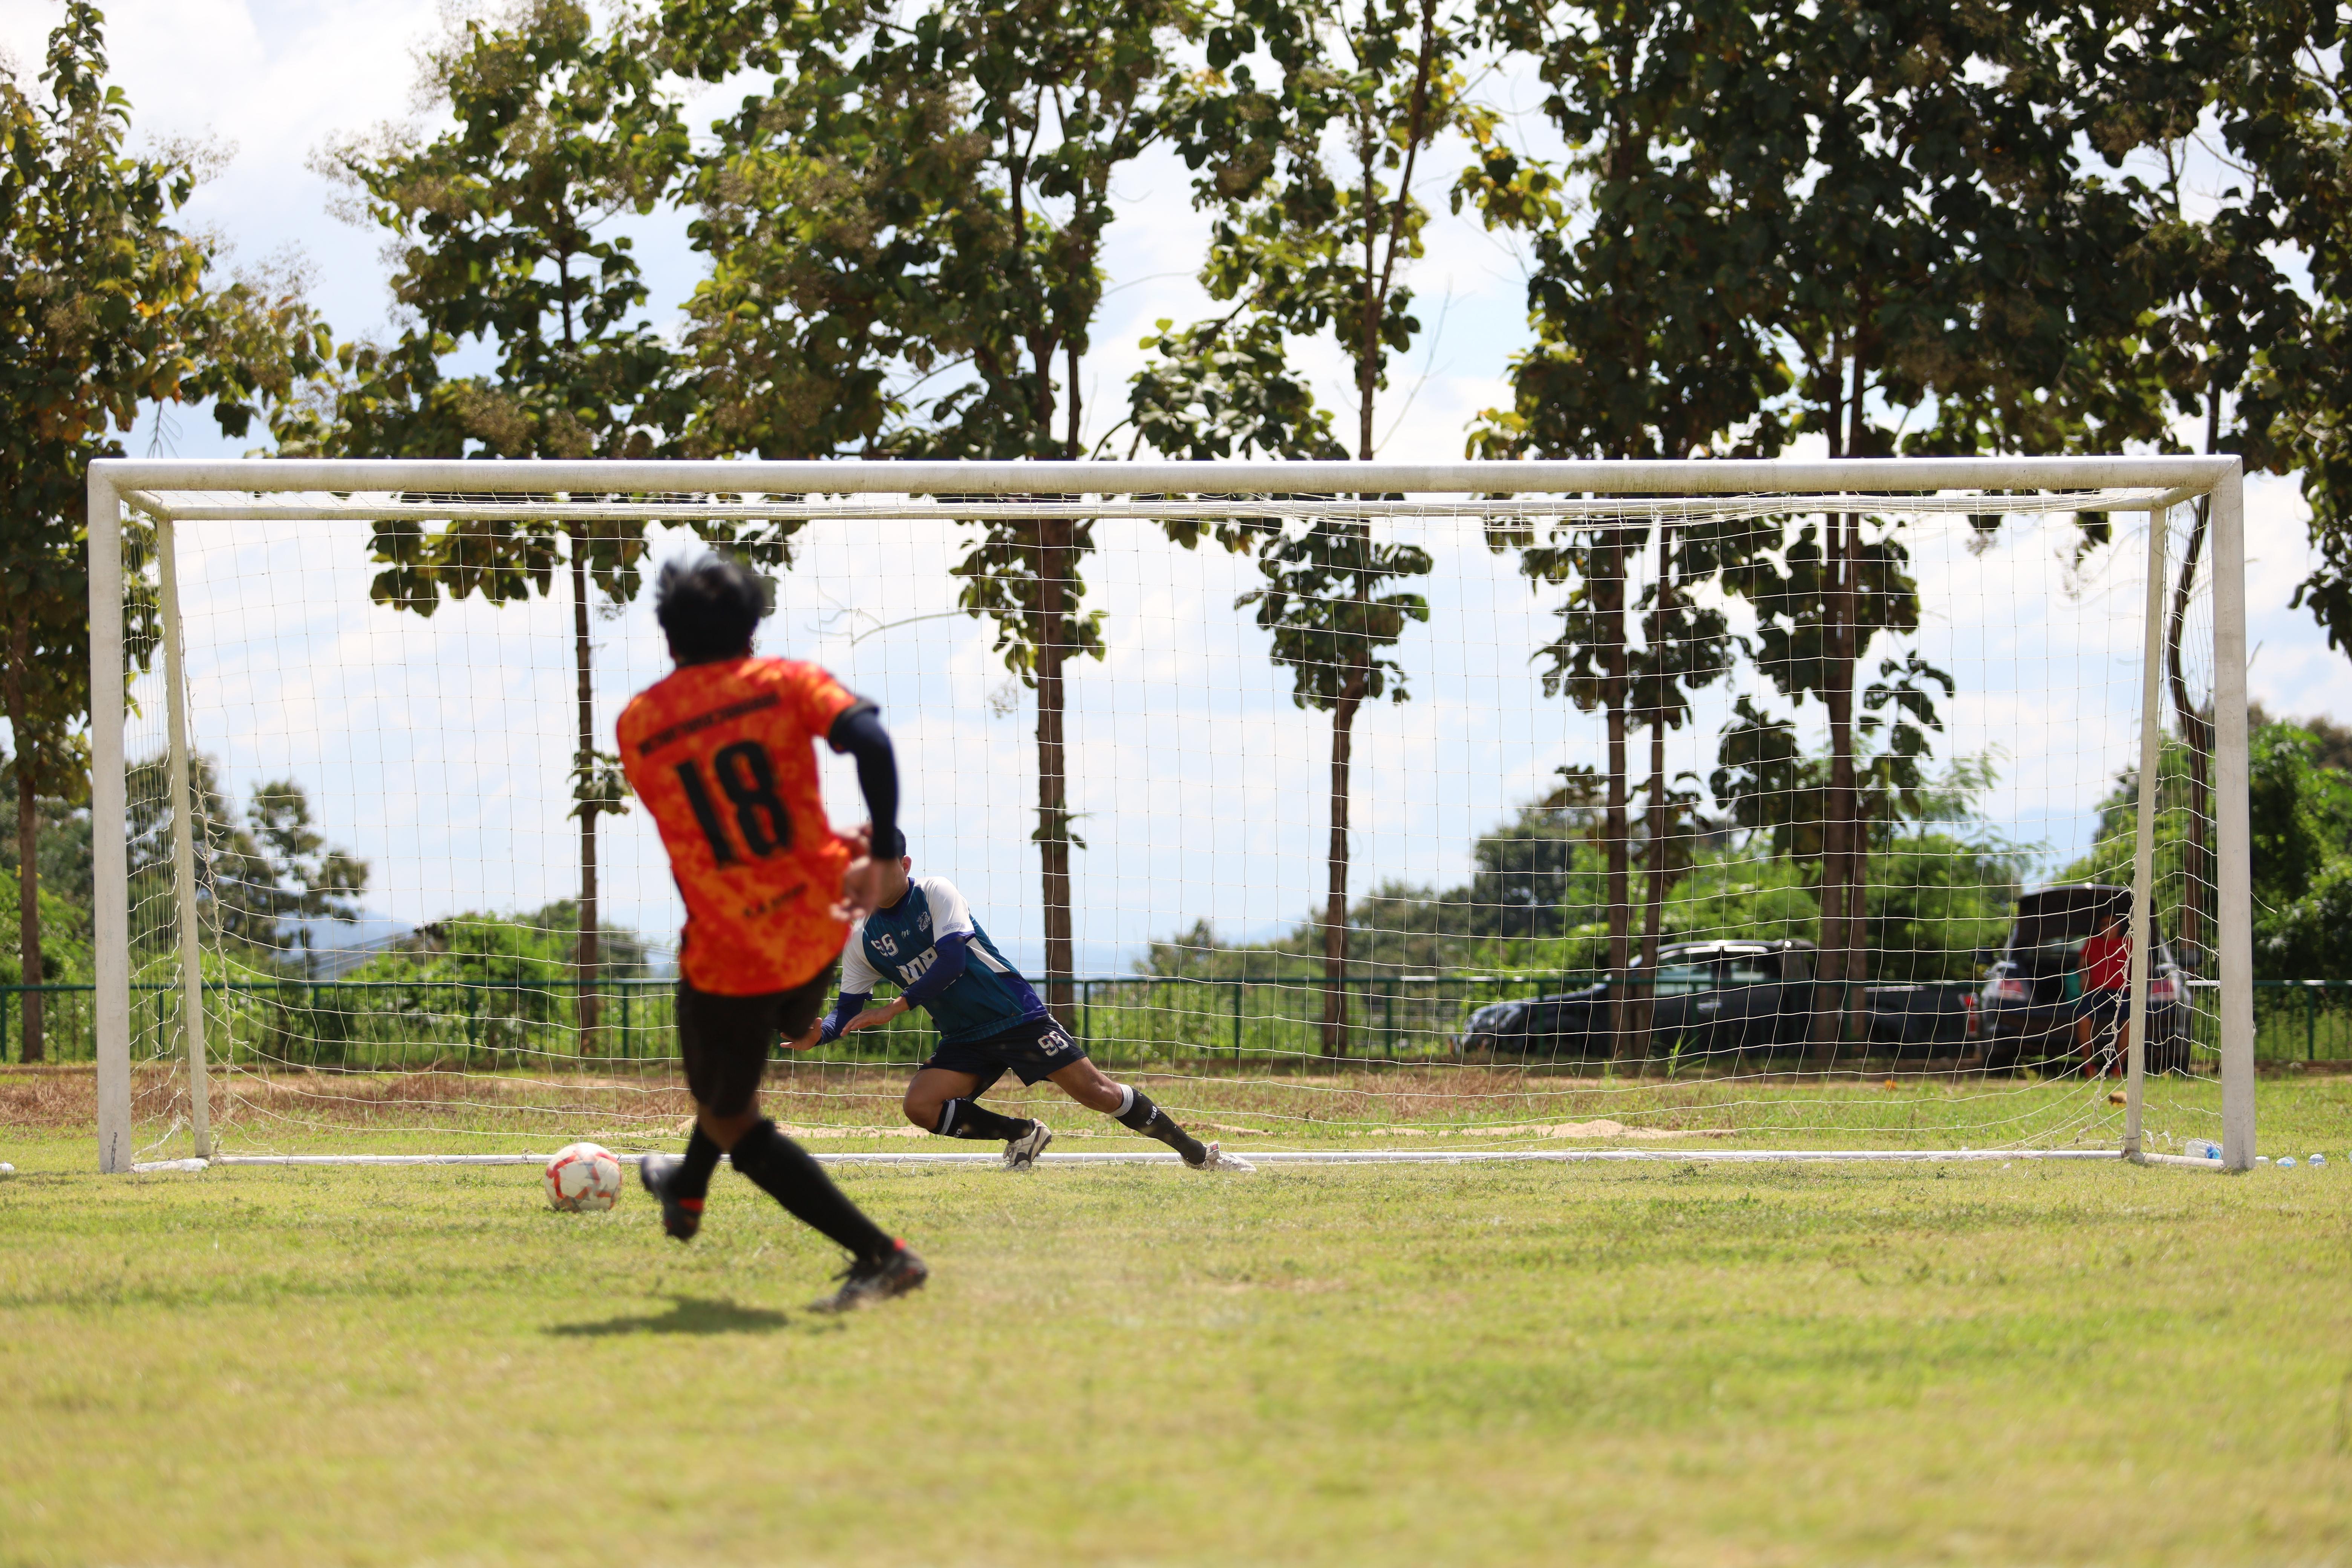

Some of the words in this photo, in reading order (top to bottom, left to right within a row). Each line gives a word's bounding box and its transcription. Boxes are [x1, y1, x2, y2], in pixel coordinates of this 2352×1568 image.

[677, 740, 790, 868] 18
[871, 933, 899, 957] 98
[1037, 1031, 1069, 1056] 98
[1146, 1106, 1157, 1125] EGO
